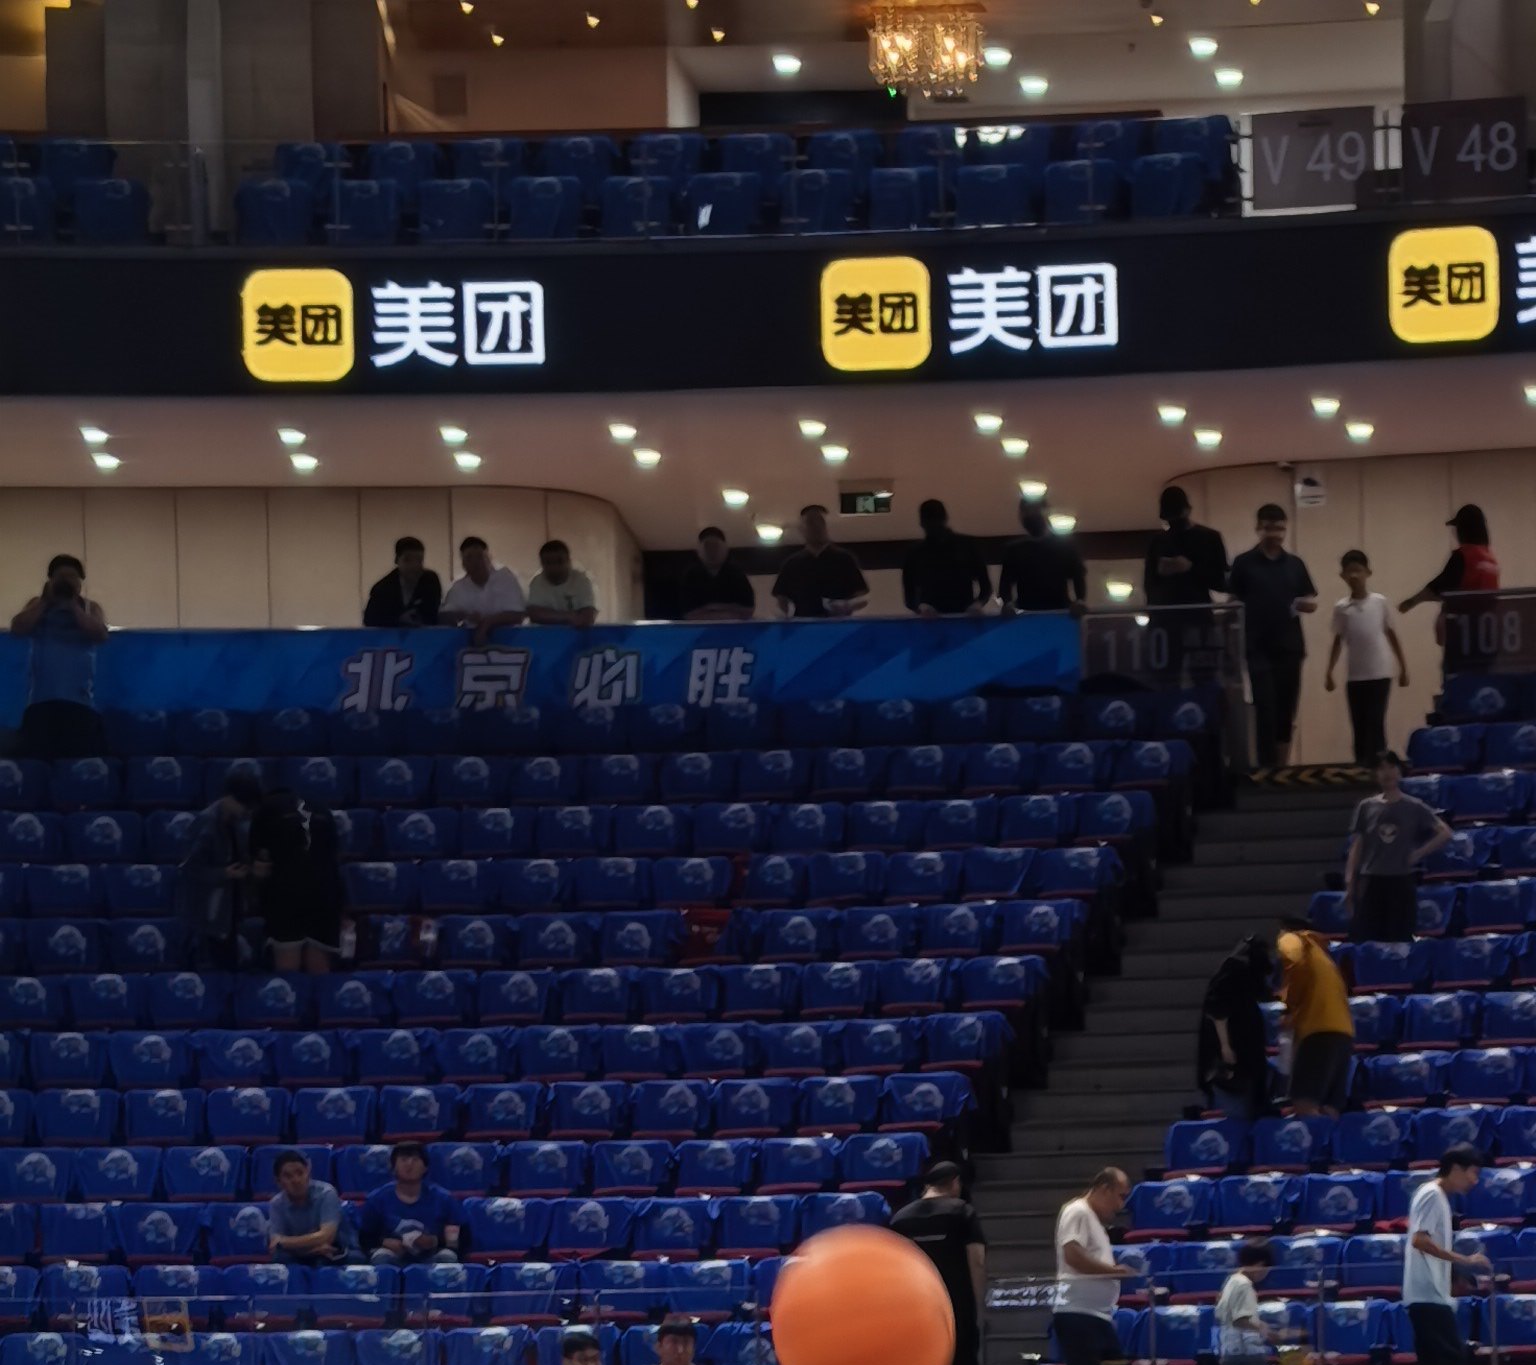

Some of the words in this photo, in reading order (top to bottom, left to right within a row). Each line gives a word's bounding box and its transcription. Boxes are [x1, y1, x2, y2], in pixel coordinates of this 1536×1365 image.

[1261, 134, 1289, 185] V
[1306, 130, 1368, 182] 49
[1410, 125, 1441, 177] V
[1456, 121, 1518, 174] 48
[948, 262, 1119, 355] 美团
[1401, 262, 1486, 309] 美团
[255, 304, 342, 348] 美团
[370, 280, 546, 369] 美团
[833, 292, 920, 336] 美团
[1101, 626, 1170, 671] 110
[1457, 609, 1522, 655] 108
[341, 646, 756, 713] 北京必胜
